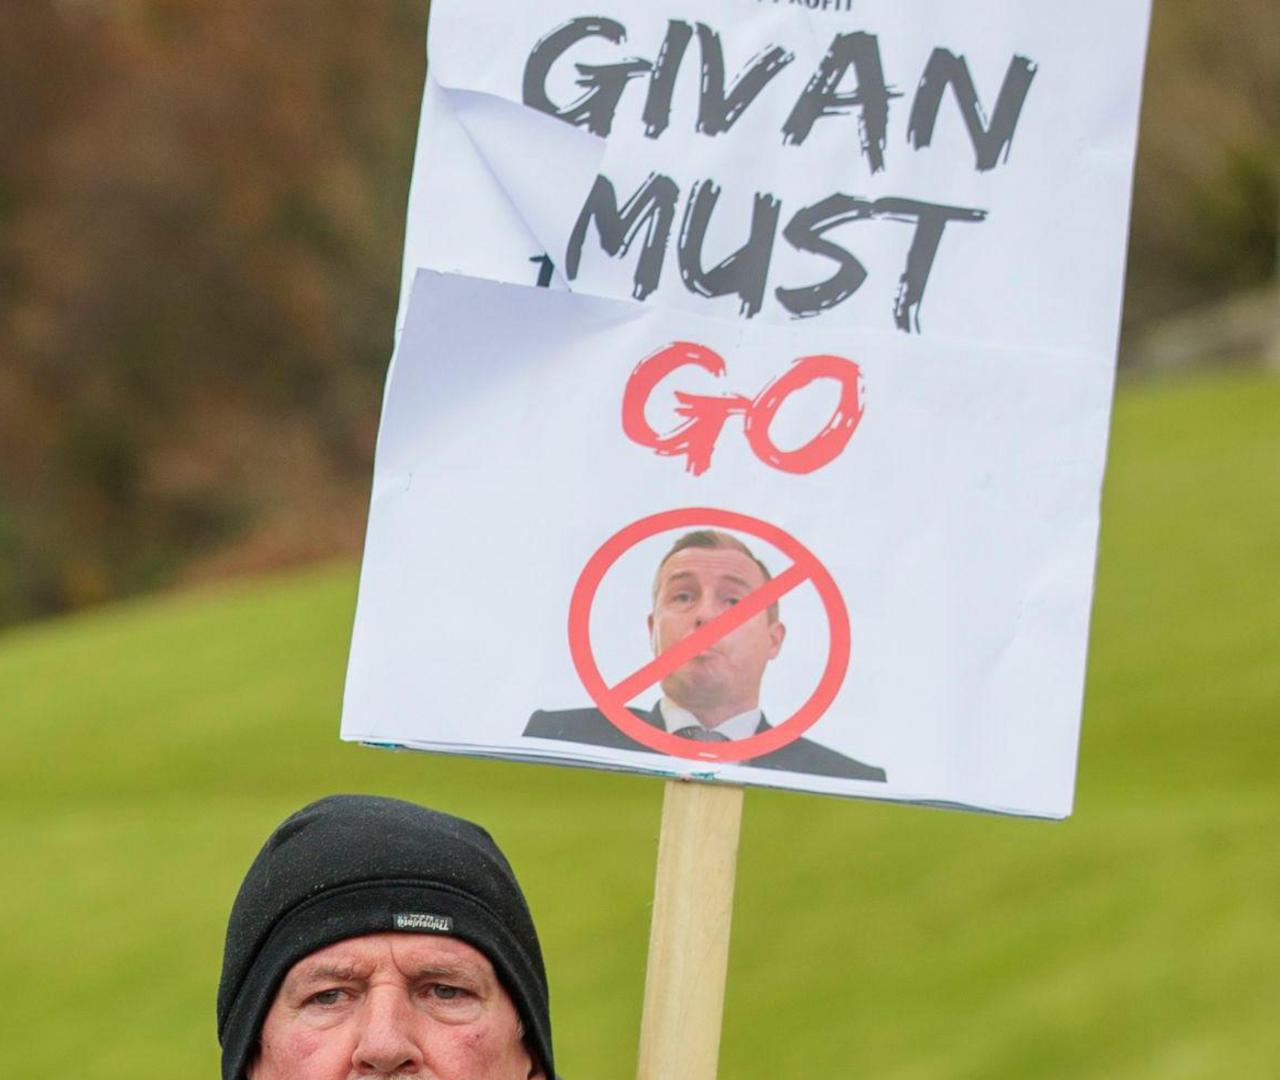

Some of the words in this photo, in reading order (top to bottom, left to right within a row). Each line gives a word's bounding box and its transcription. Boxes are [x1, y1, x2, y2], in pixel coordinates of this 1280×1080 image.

[522, 15, 1038, 174] GIVAN
[565, 172, 988, 335] MUST
[621, 340, 865, 477] GO
